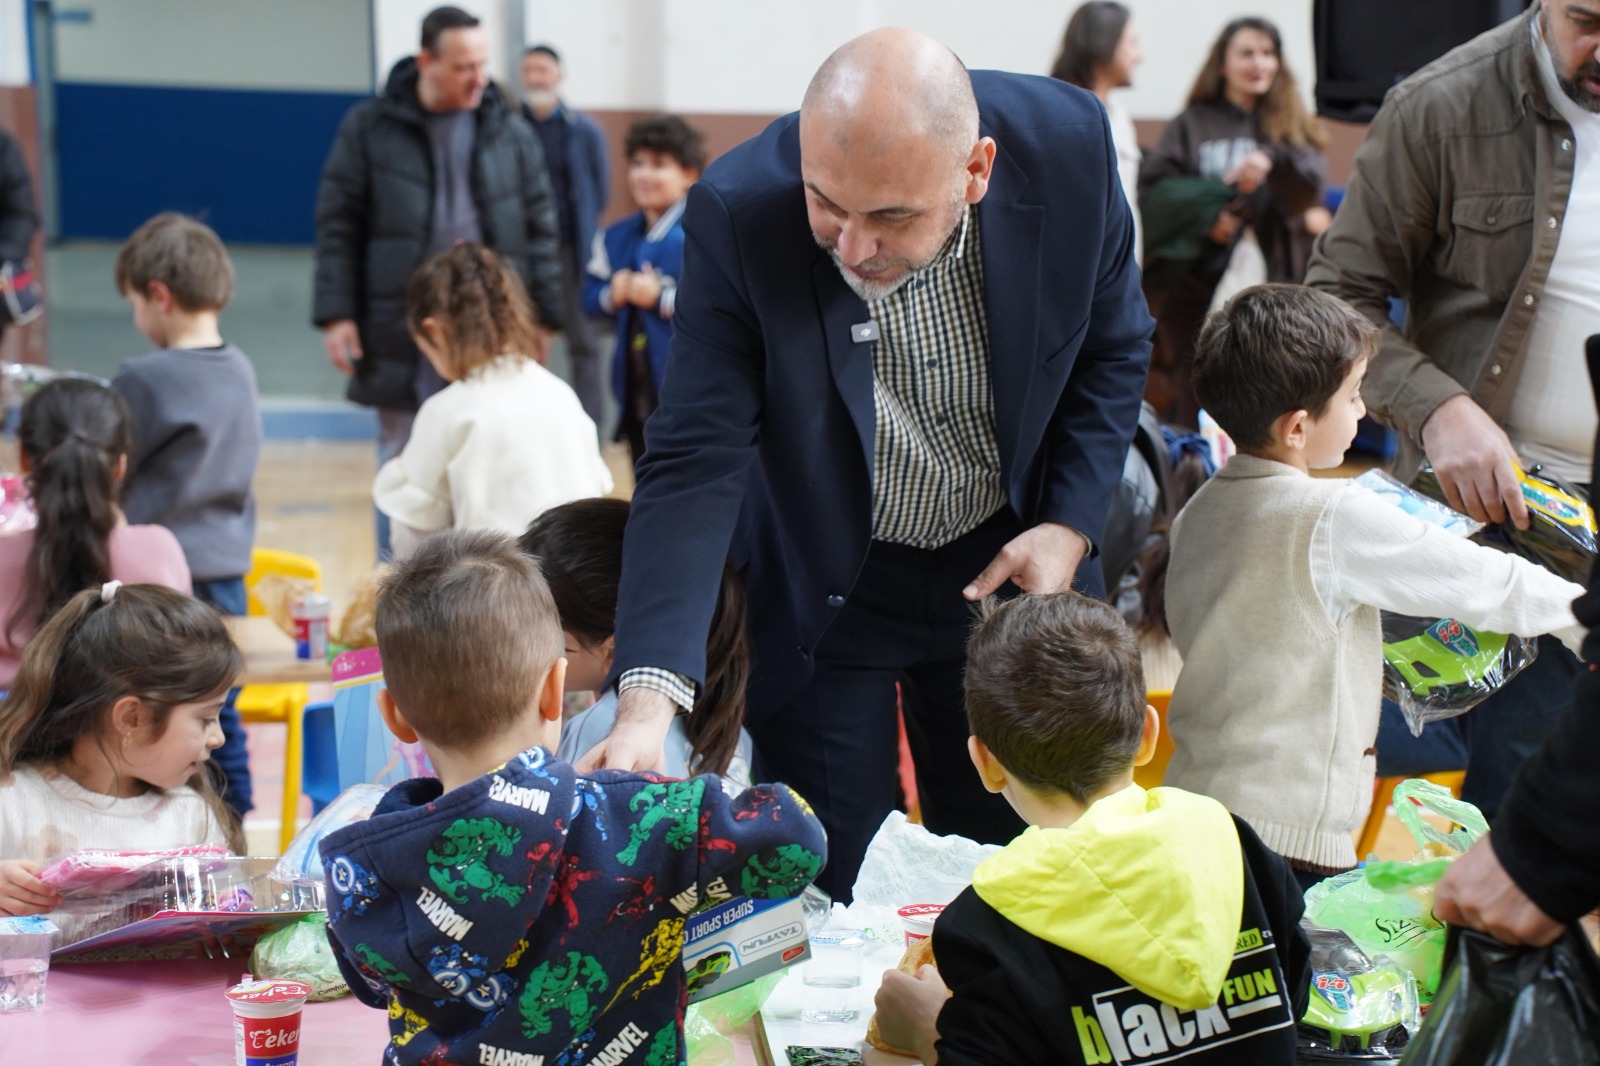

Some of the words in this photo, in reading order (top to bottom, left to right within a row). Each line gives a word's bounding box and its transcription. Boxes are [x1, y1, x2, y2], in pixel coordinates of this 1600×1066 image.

[1438, 619, 1461, 644] 14
[488, 774, 551, 816] MARVEL
[415, 886, 474, 942] MARVEL
[722, 899, 754, 926] SUPER
[690, 914, 722, 941] SPORT
[742, 926, 799, 952] TAYFUN
[1222, 968, 1278, 1006] FUN
[1316, 976, 1347, 990] 14
